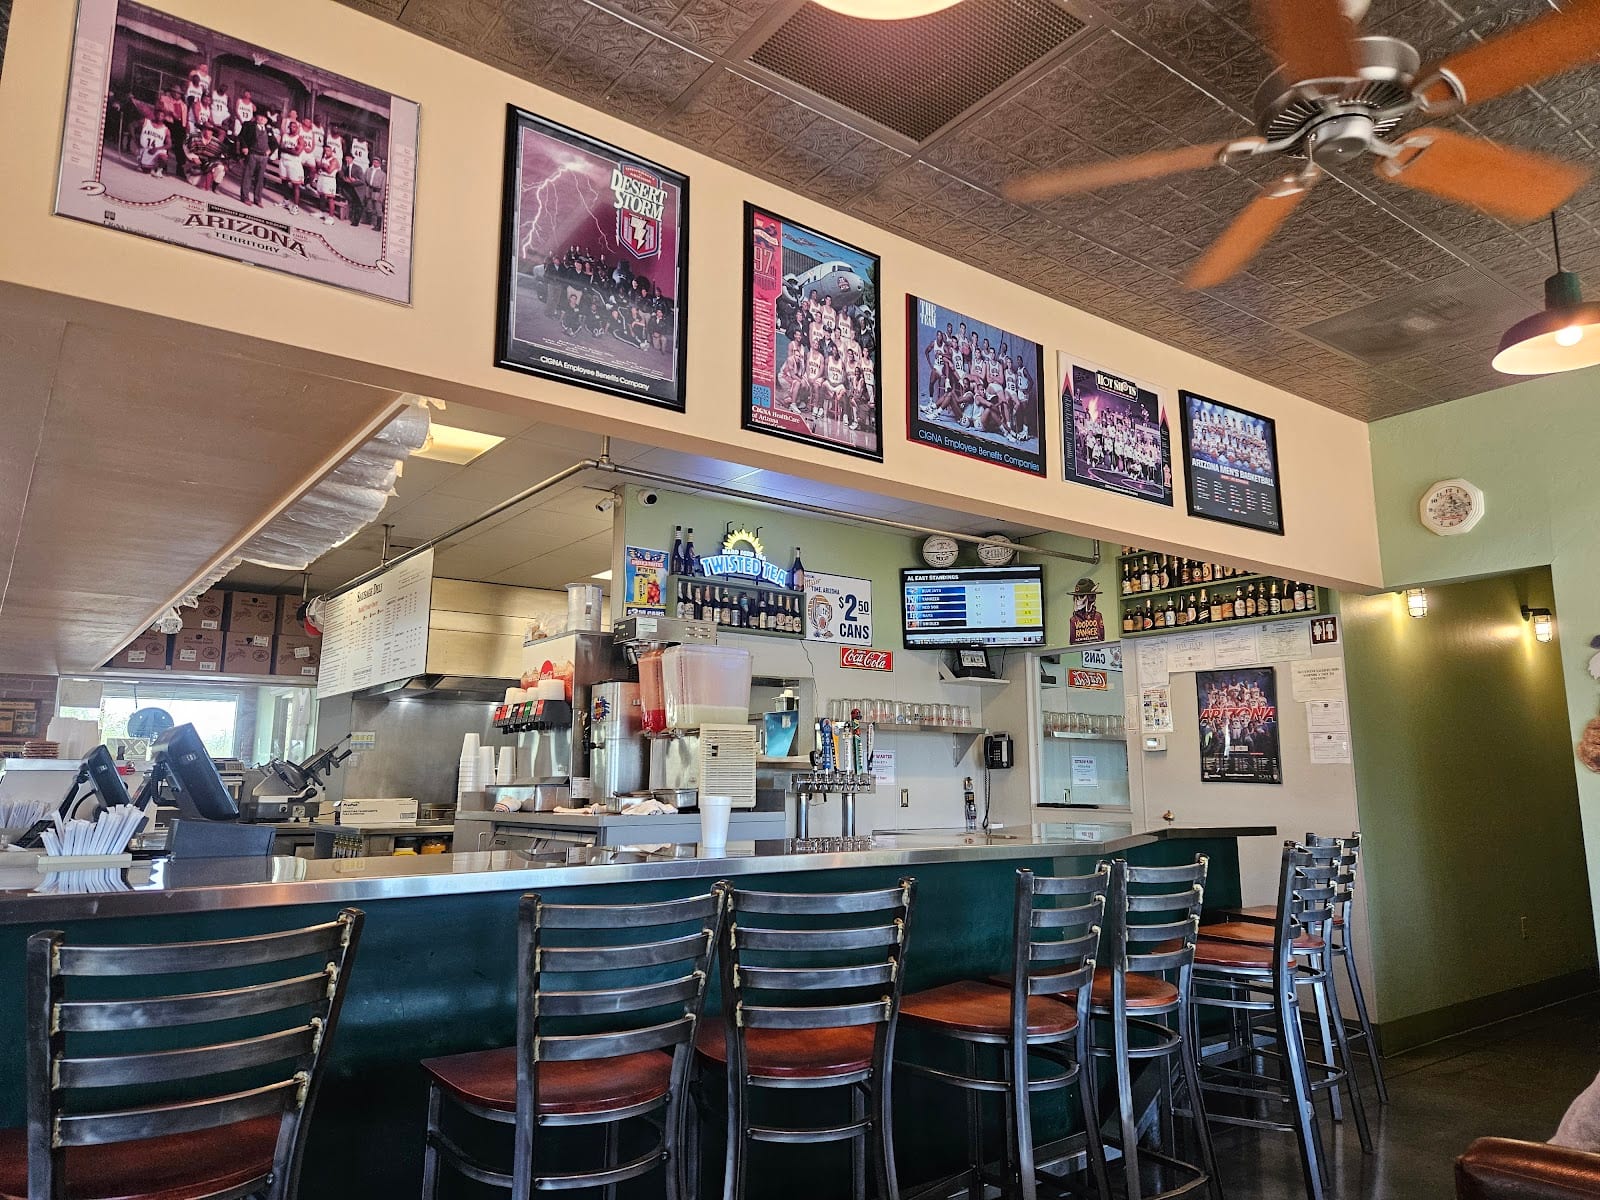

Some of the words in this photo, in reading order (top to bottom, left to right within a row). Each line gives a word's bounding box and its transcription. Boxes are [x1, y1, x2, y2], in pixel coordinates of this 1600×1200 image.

[610, 168, 668, 206] DESERT
[614, 190, 664, 222] STORM
[183, 214, 310, 260] ARIZONA
[216, 232, 280, 254] TERRITORY
[920, 300, 936, 316] THE
[540, 356, 564, 368] CIGNA
[564, 362, 595, 376] Employee
[596, 370, 620, 382] Benefits
[620, 376, 650, 391] Company
[1097, 374, 1114, 388] HOT
[1114, 380, 1136, 396] SHOTS
[752, 406, 771, 416] CIGNA
[772, 412, 800, 424] HealthCare
[758, 414, 778, 424] Arizona
[918, 429, 943, 444] CIGNA
[944, 436, 978, 454] Employee
[978, 447, 1002, 460] Benefits
[1004, 454, 1040, 472] Companies
[1192, 458, 1220, 472] ARIZONA
[1220, 465, 1240, 477] MEN'S
[1240, 470, 1274, 487] BASKETBALL
[700, 555, 760, 577] TWISTED
[762, 561, 788, 588] TEA
[374, 583, 383, 595] DELI
[840, 622, 870, 640] CANS
[1075, 620, 1098, 630] VOODOO
[1075, 628, 1098, 638] RANGER
[1200, 706, 1276, 725] ARIZONA
